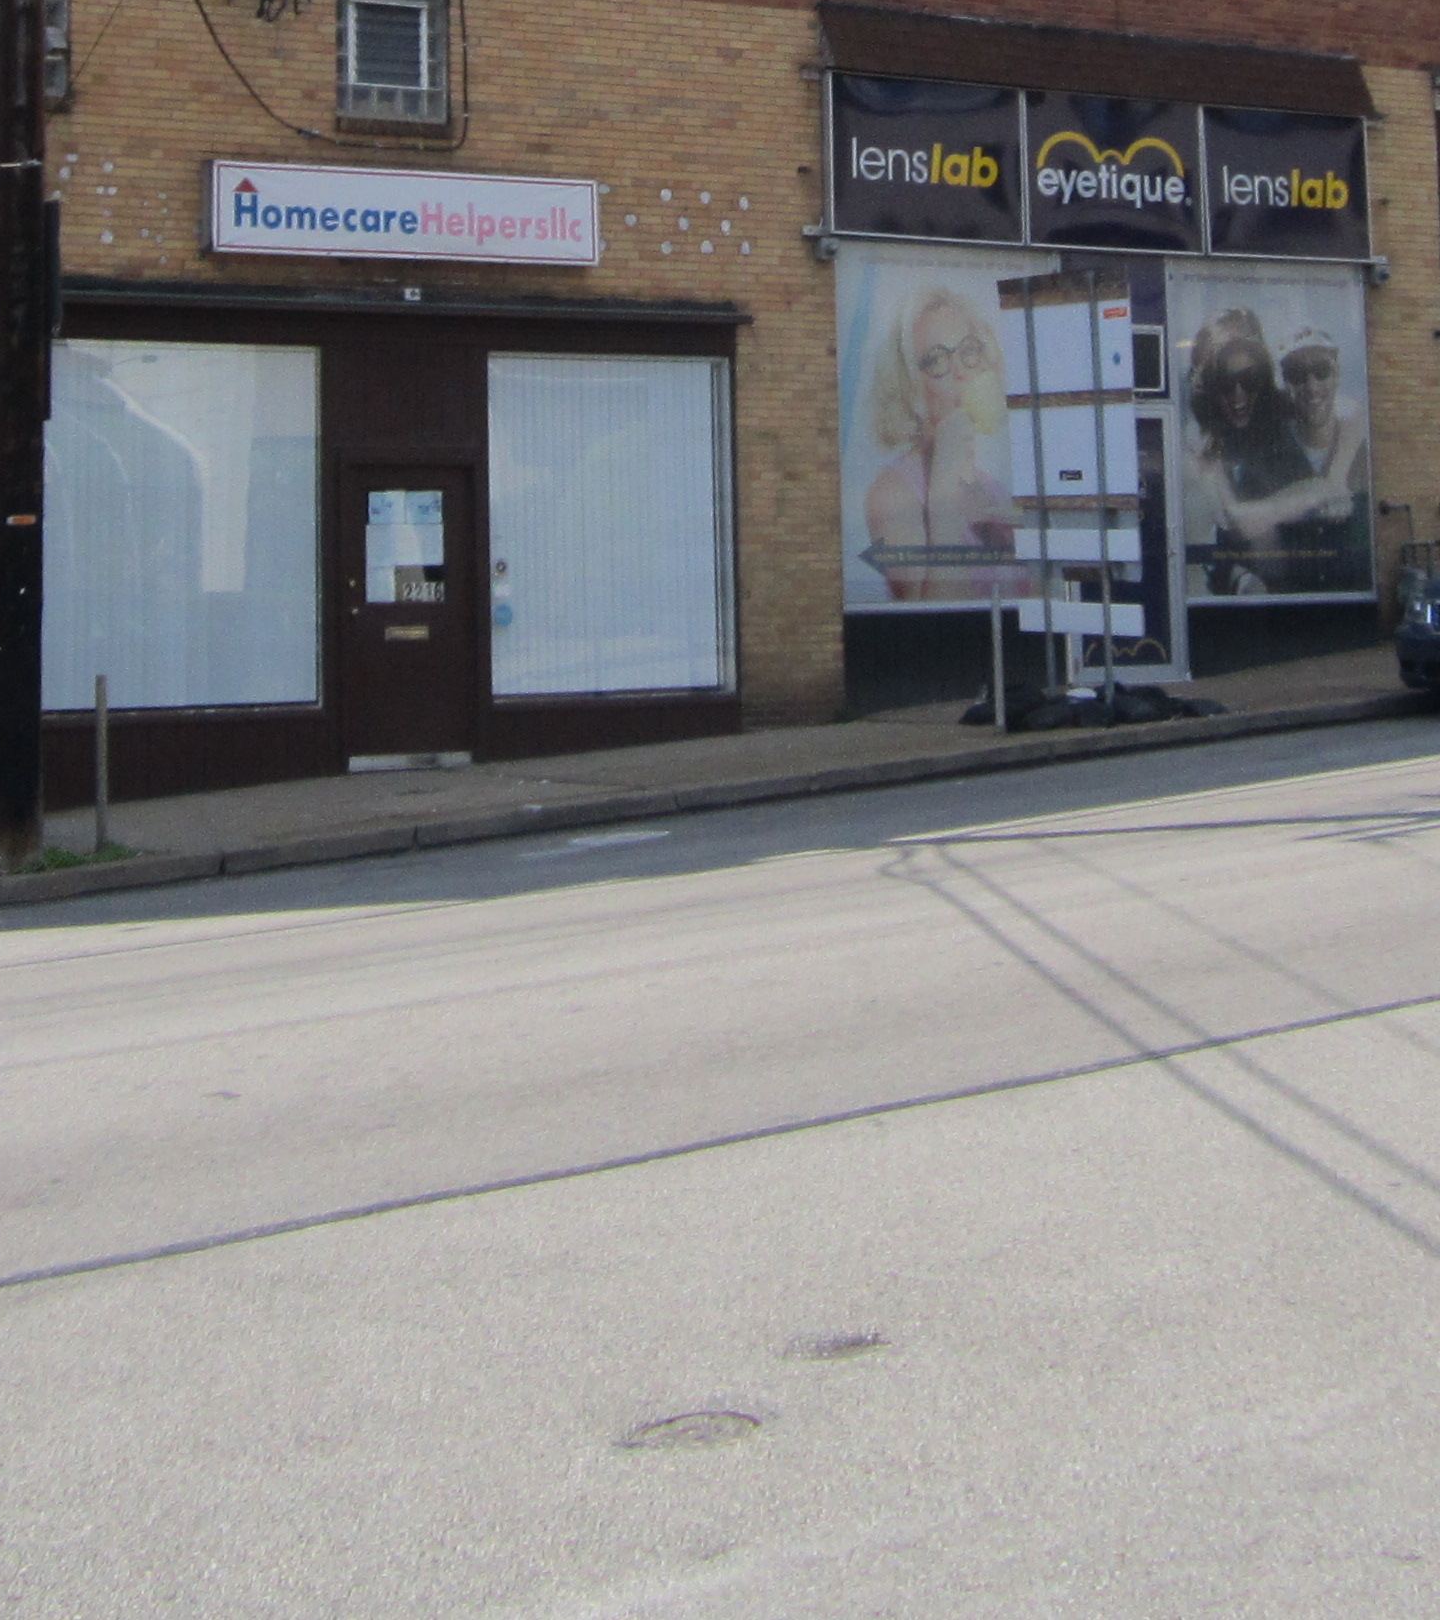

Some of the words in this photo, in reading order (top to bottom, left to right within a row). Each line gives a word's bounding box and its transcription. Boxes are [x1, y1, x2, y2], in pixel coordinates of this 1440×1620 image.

[850, 136, 999, 188] lenslab
[1222, 165, 1349, 209] lenslab
[402, 581, 444, 602] 2216
